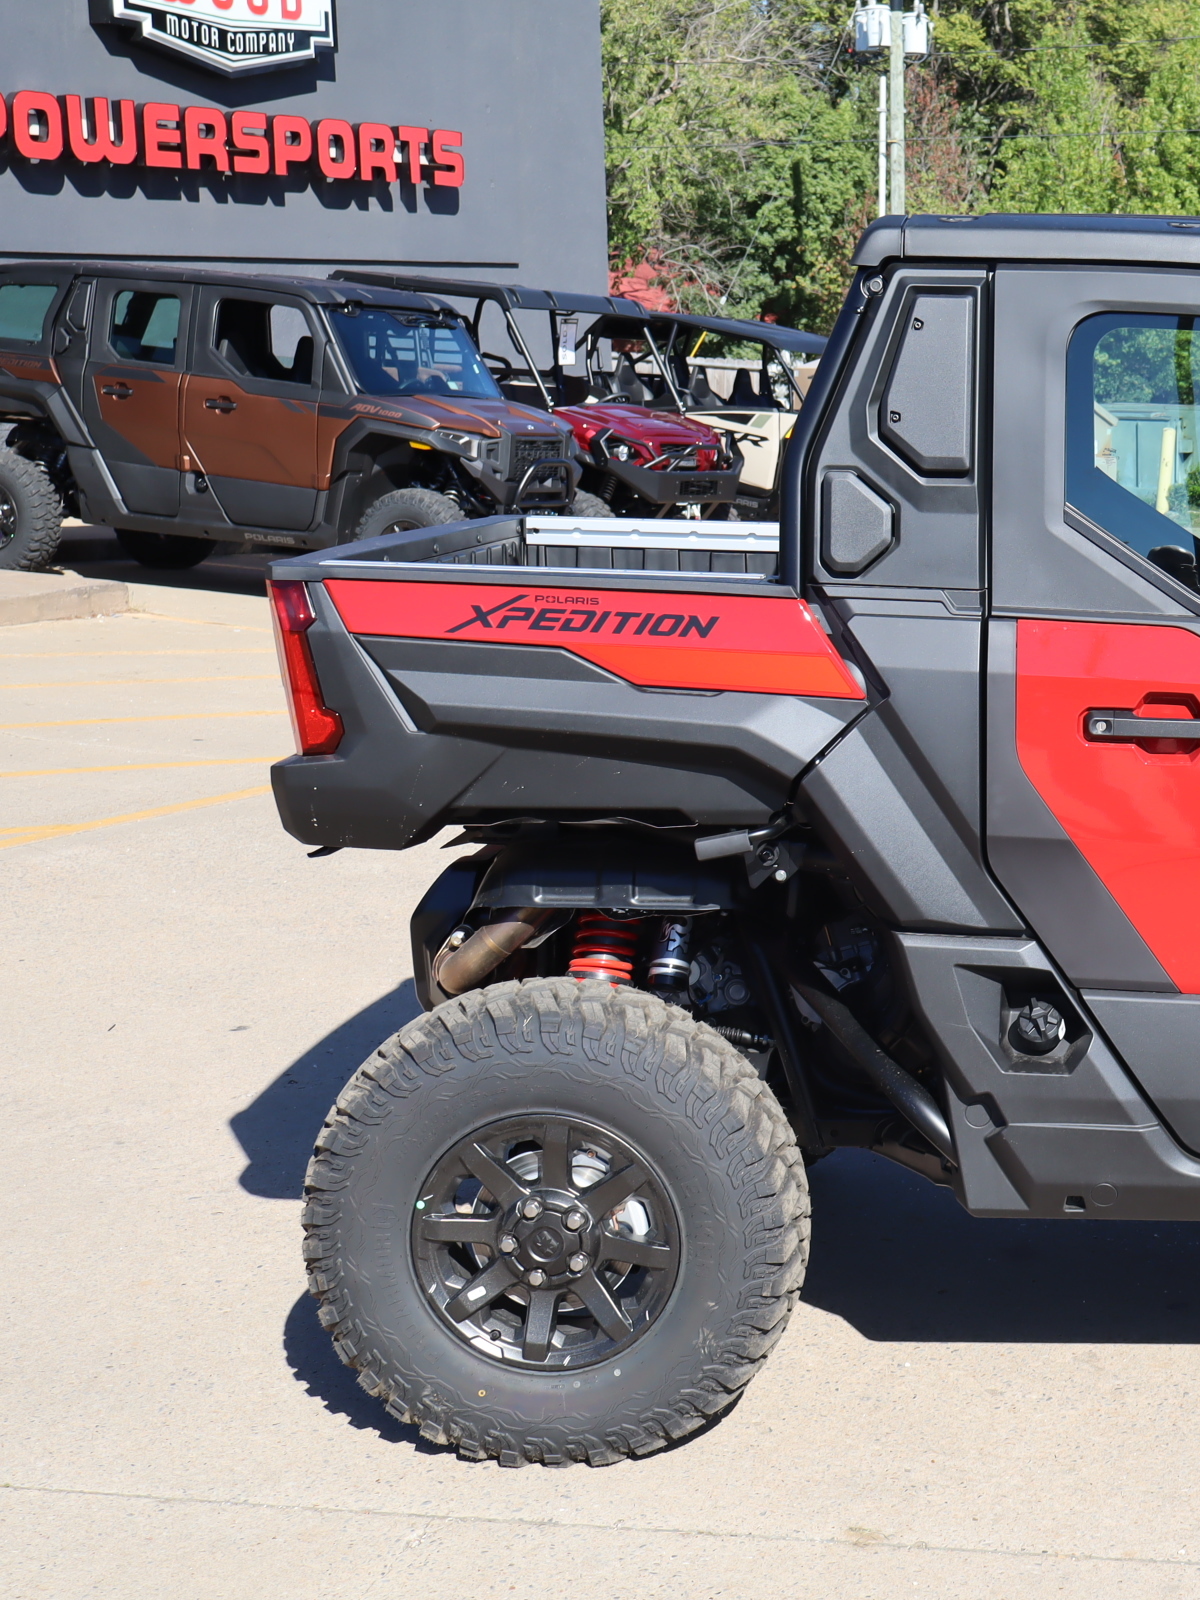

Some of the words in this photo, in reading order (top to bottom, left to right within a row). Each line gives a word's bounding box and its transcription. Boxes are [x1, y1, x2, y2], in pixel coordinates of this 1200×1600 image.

[166, 13, 219, 48] MOTOR
[227, 32, 295, 54] COMPANY
[0, 90, 464, 187] OWERSPORTS
[349, 403, 381, 413] ADV
[378, 409, 402, 419] 1000
[244, 532, 295, 544] POLARIS
[534, 595, 600, 606] POLARIS
[444, 594, 720, 638] XPEDITION
